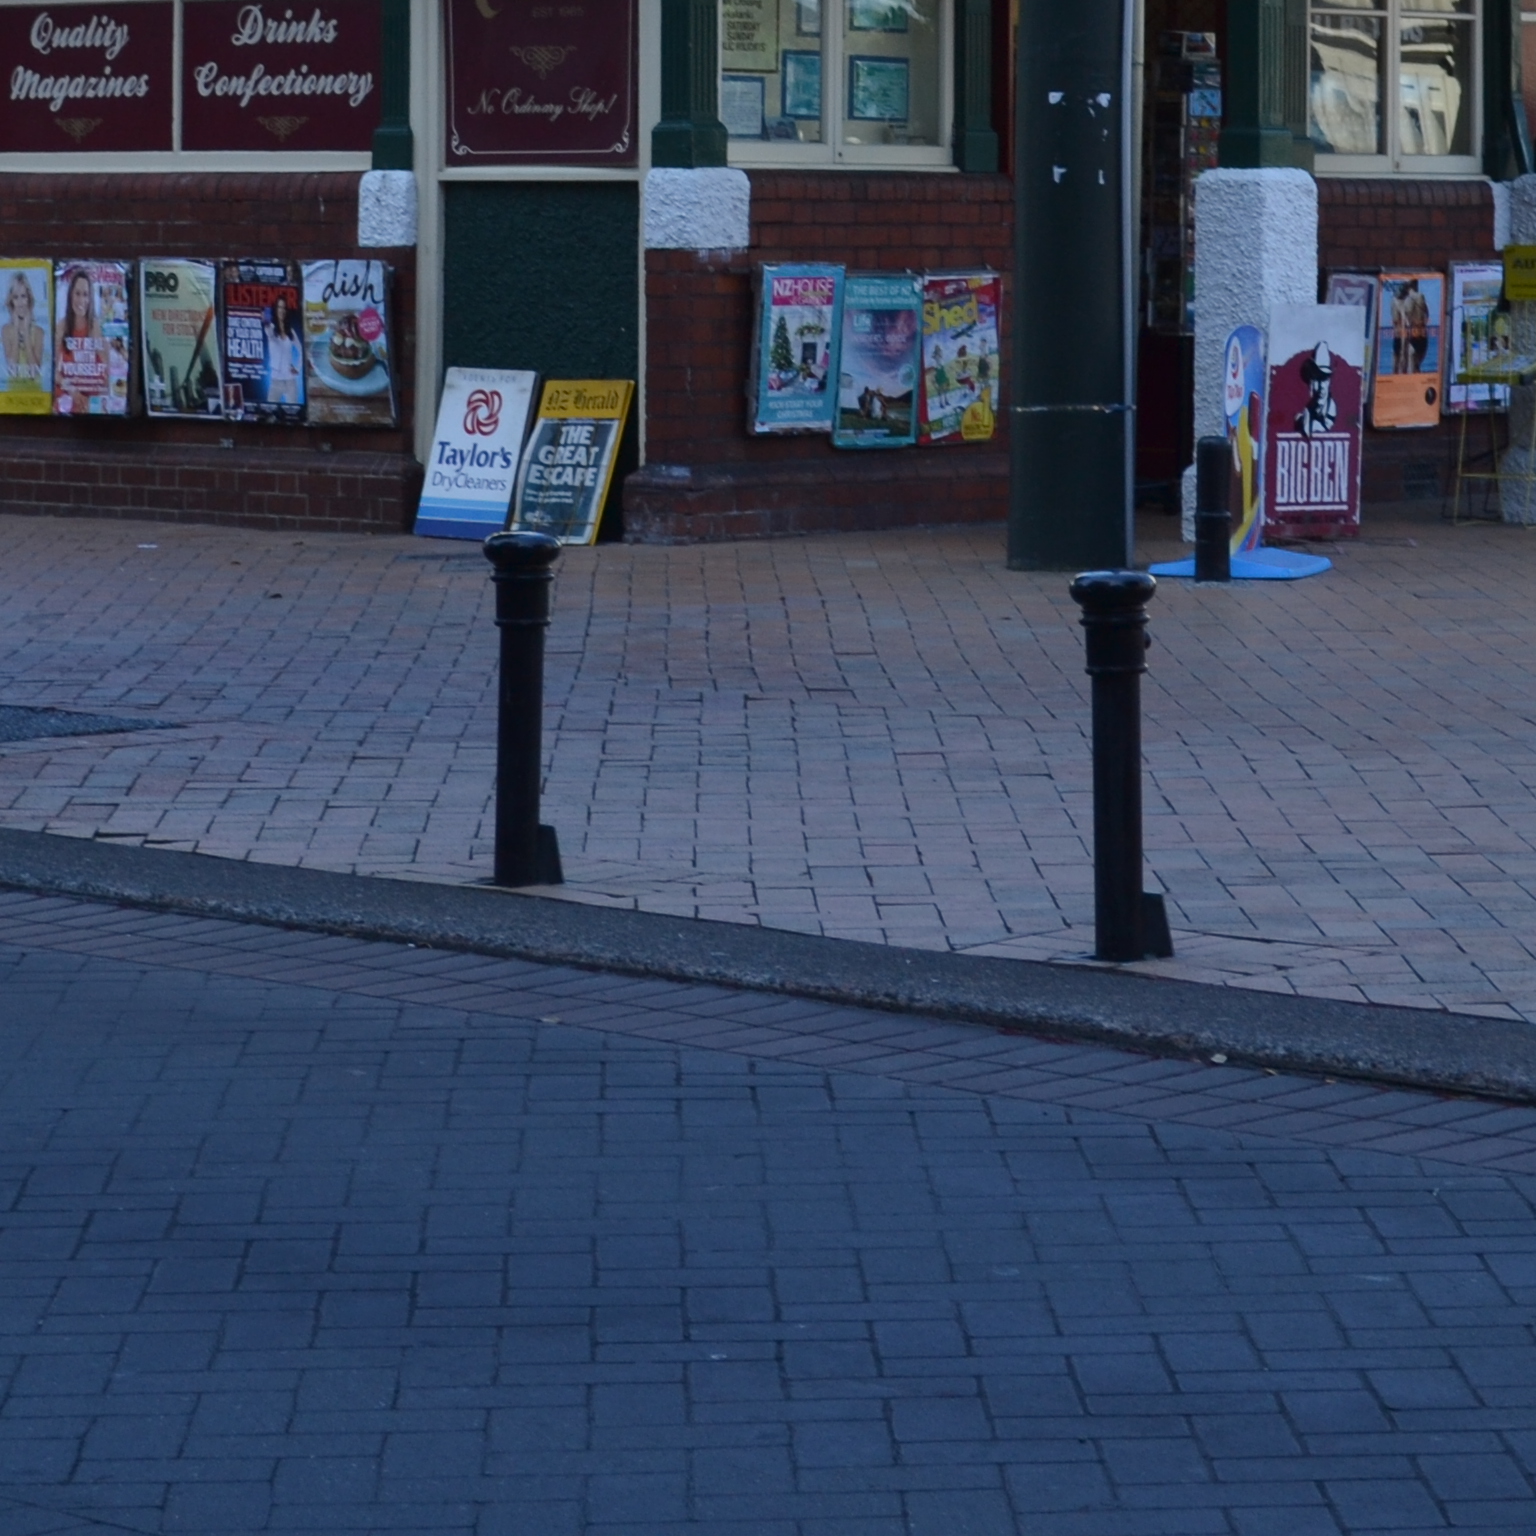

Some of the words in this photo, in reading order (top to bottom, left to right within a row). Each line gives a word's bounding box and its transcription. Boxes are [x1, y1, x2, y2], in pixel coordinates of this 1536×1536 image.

[31, 12, 129, 59] Quality
[231, 5, 337, 47] Drinks
[10, 65, 149, 112] Magazines
[195, 62, 373, 107] Confectionery
[467, 88, 501, 114] No
[501, 87, 563, 122] Ordinary
[567, 86, 618, 121] Shop!
[145, 271, 179, 292] PRO
[232, 284, 299, 310] LISTENER
[323, 260, 385, 304] dish
[922, 293, 978, 335] Shed
[228, 339, 264, 359] HEALTH
[574, 388, 619, 411] Herald
[560, 425, 595, 445] THE
[437, 441, 512, 472] Taylor's
[538, 444, 600, 466] GREAT
[527, 465, 598, 487] ESCAPE
